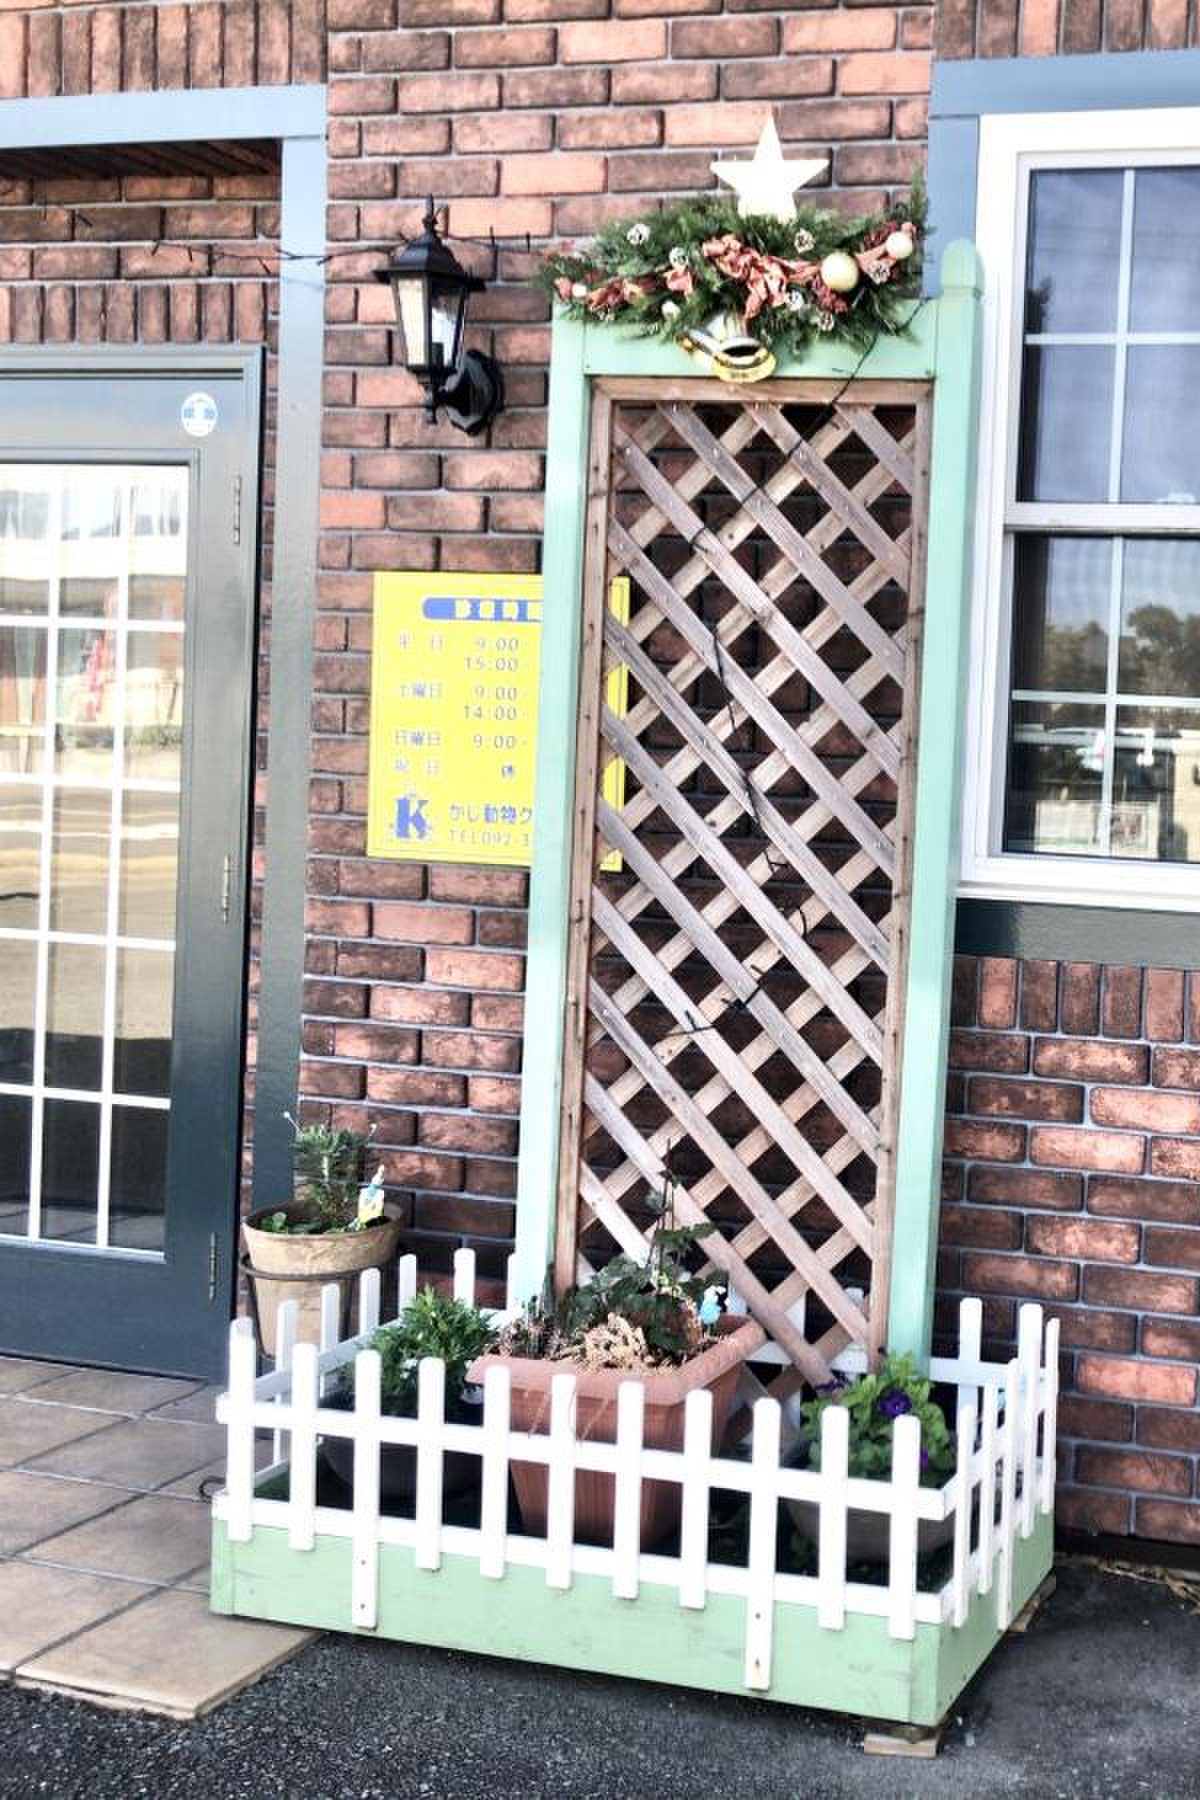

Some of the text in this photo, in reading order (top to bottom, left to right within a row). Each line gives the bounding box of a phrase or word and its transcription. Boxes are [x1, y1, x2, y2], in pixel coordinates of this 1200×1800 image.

[464, 656, 519, 671] 15:00
[464, 705, 518, 721] 14:00
[395, 797, 430, 840] K
